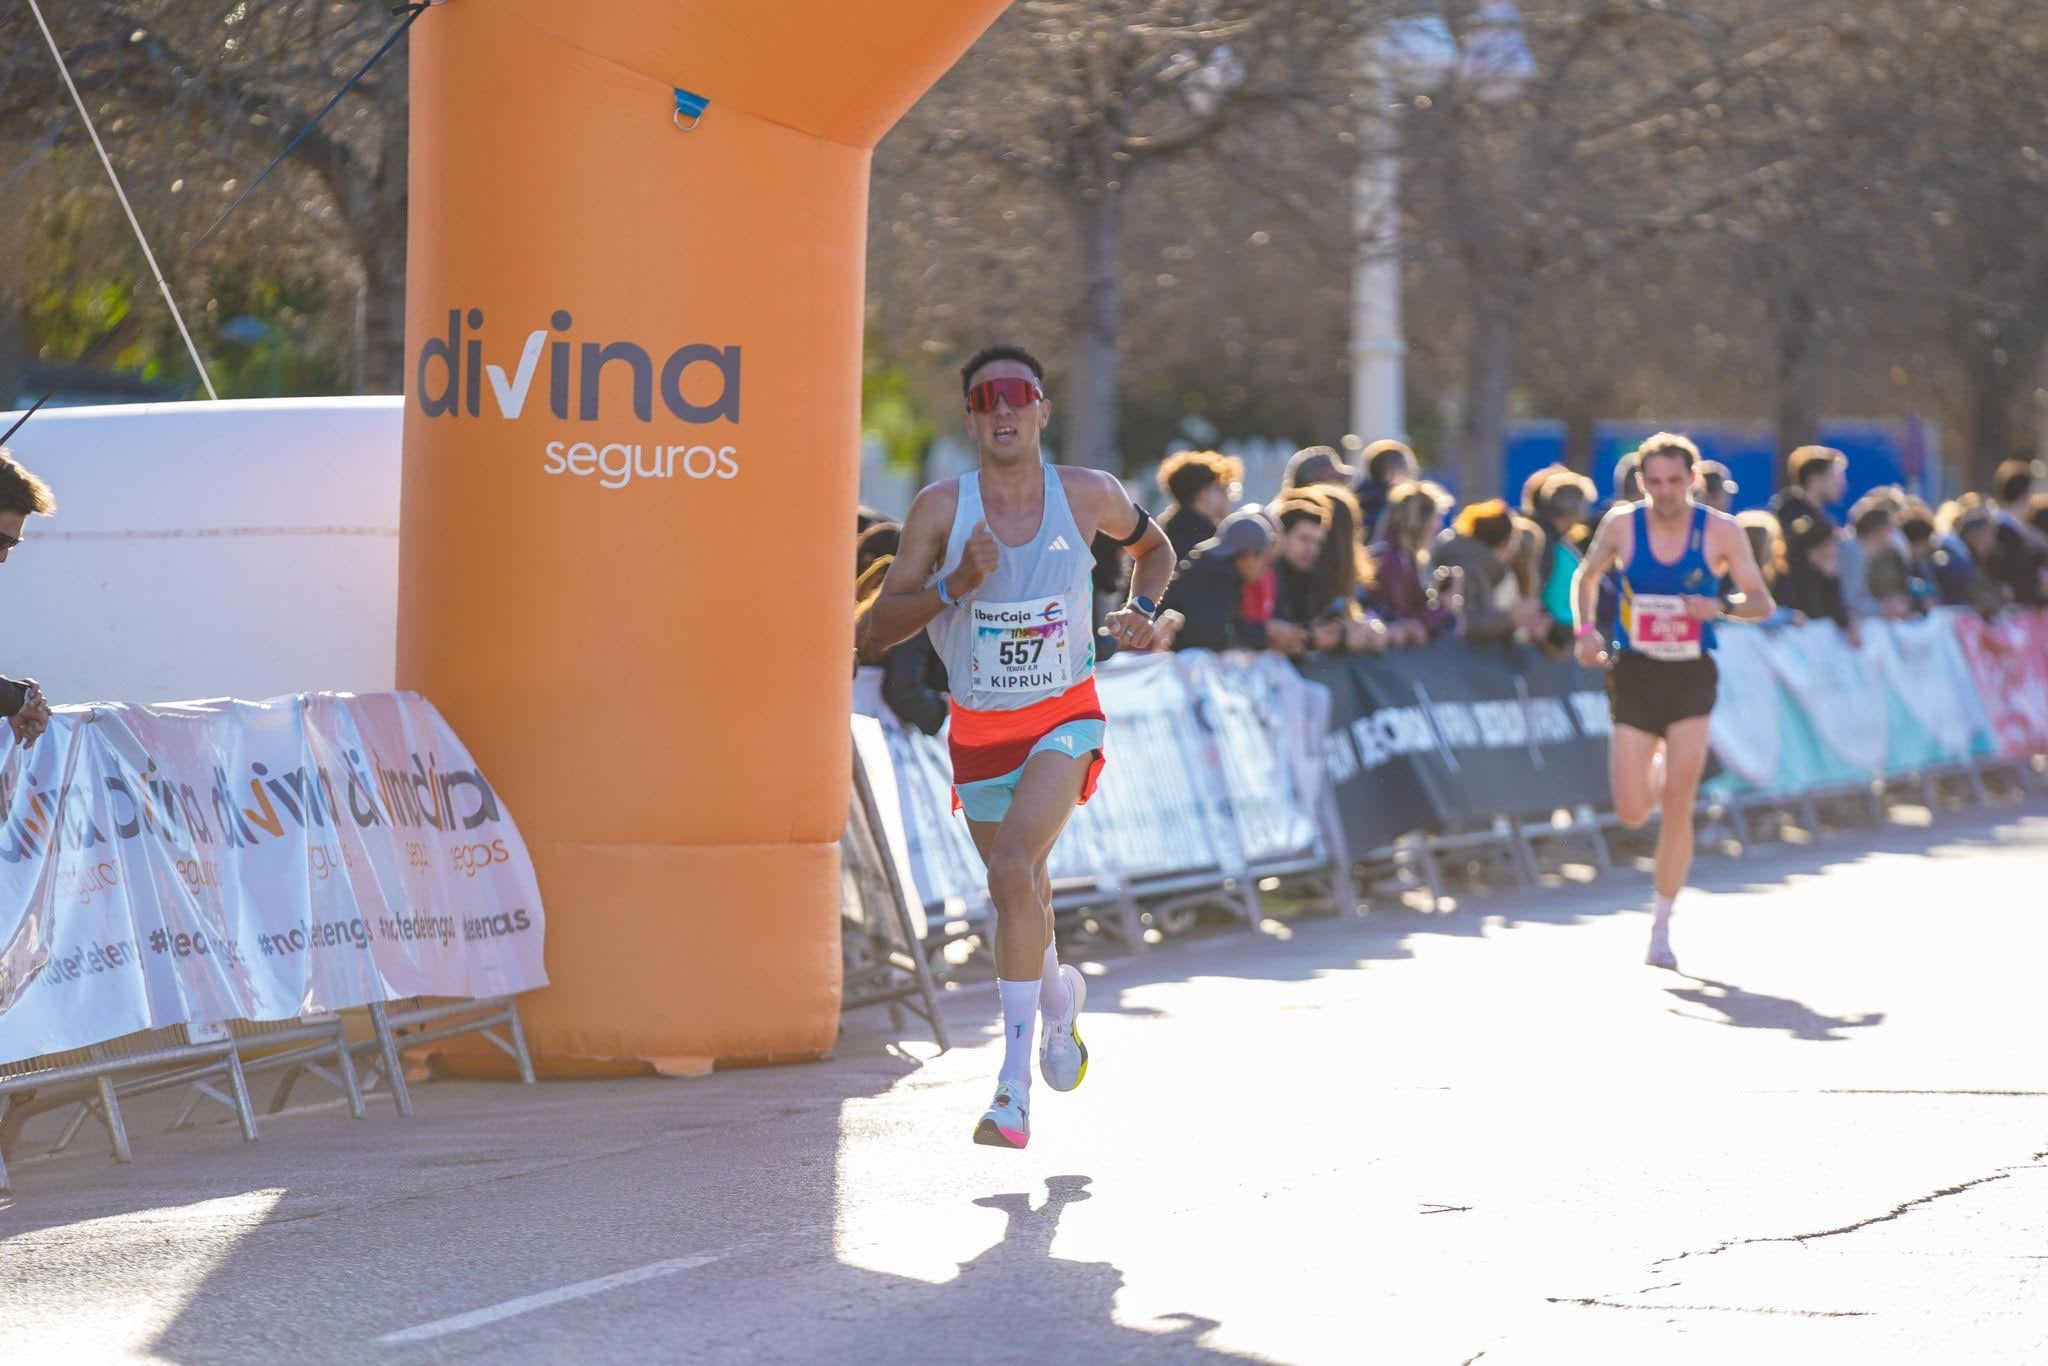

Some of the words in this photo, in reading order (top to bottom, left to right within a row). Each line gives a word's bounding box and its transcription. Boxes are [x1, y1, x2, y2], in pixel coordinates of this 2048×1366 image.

[417, 307, 742, 424] divina
[543, 440, 739, 489] seguros
[1000, 638, 1044, 664] 557
[991, 672, 1052, 687] KIPRUN
